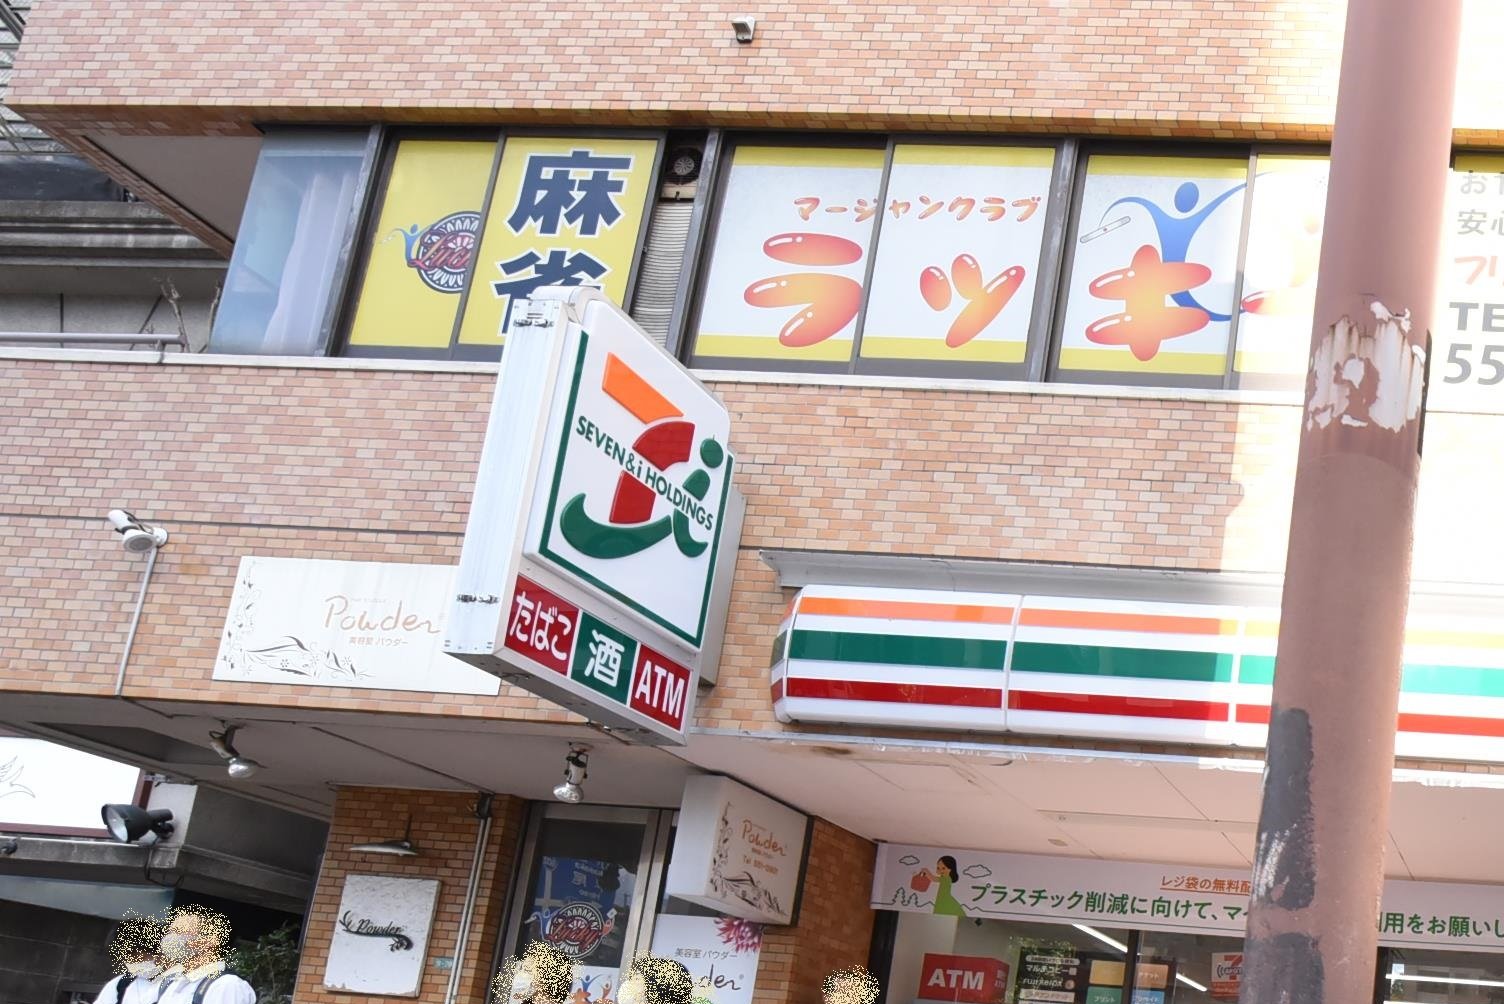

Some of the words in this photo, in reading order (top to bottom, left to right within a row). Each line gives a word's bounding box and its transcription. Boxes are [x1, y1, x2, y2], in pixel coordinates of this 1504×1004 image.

[794, 195, 1042, 223] マージャンクラブ
[744, 232, 1275, 362] ラッキ
[645, 464, 714, 531] HOLDINGS
[325, 594, 441, 634] Powder
[509, 591, 572, 661] たばこ
[584, 629, 625, 688] 酒
[635, 660, 686, 719] ATM
[743, 818, 787, 857] Powder
[356, 918, 404, 933] Powder
[674, 947, 702, 958] 美容室
[702, 949, 738, 959] パウダー
[927, 967, 985, 990] ATM
